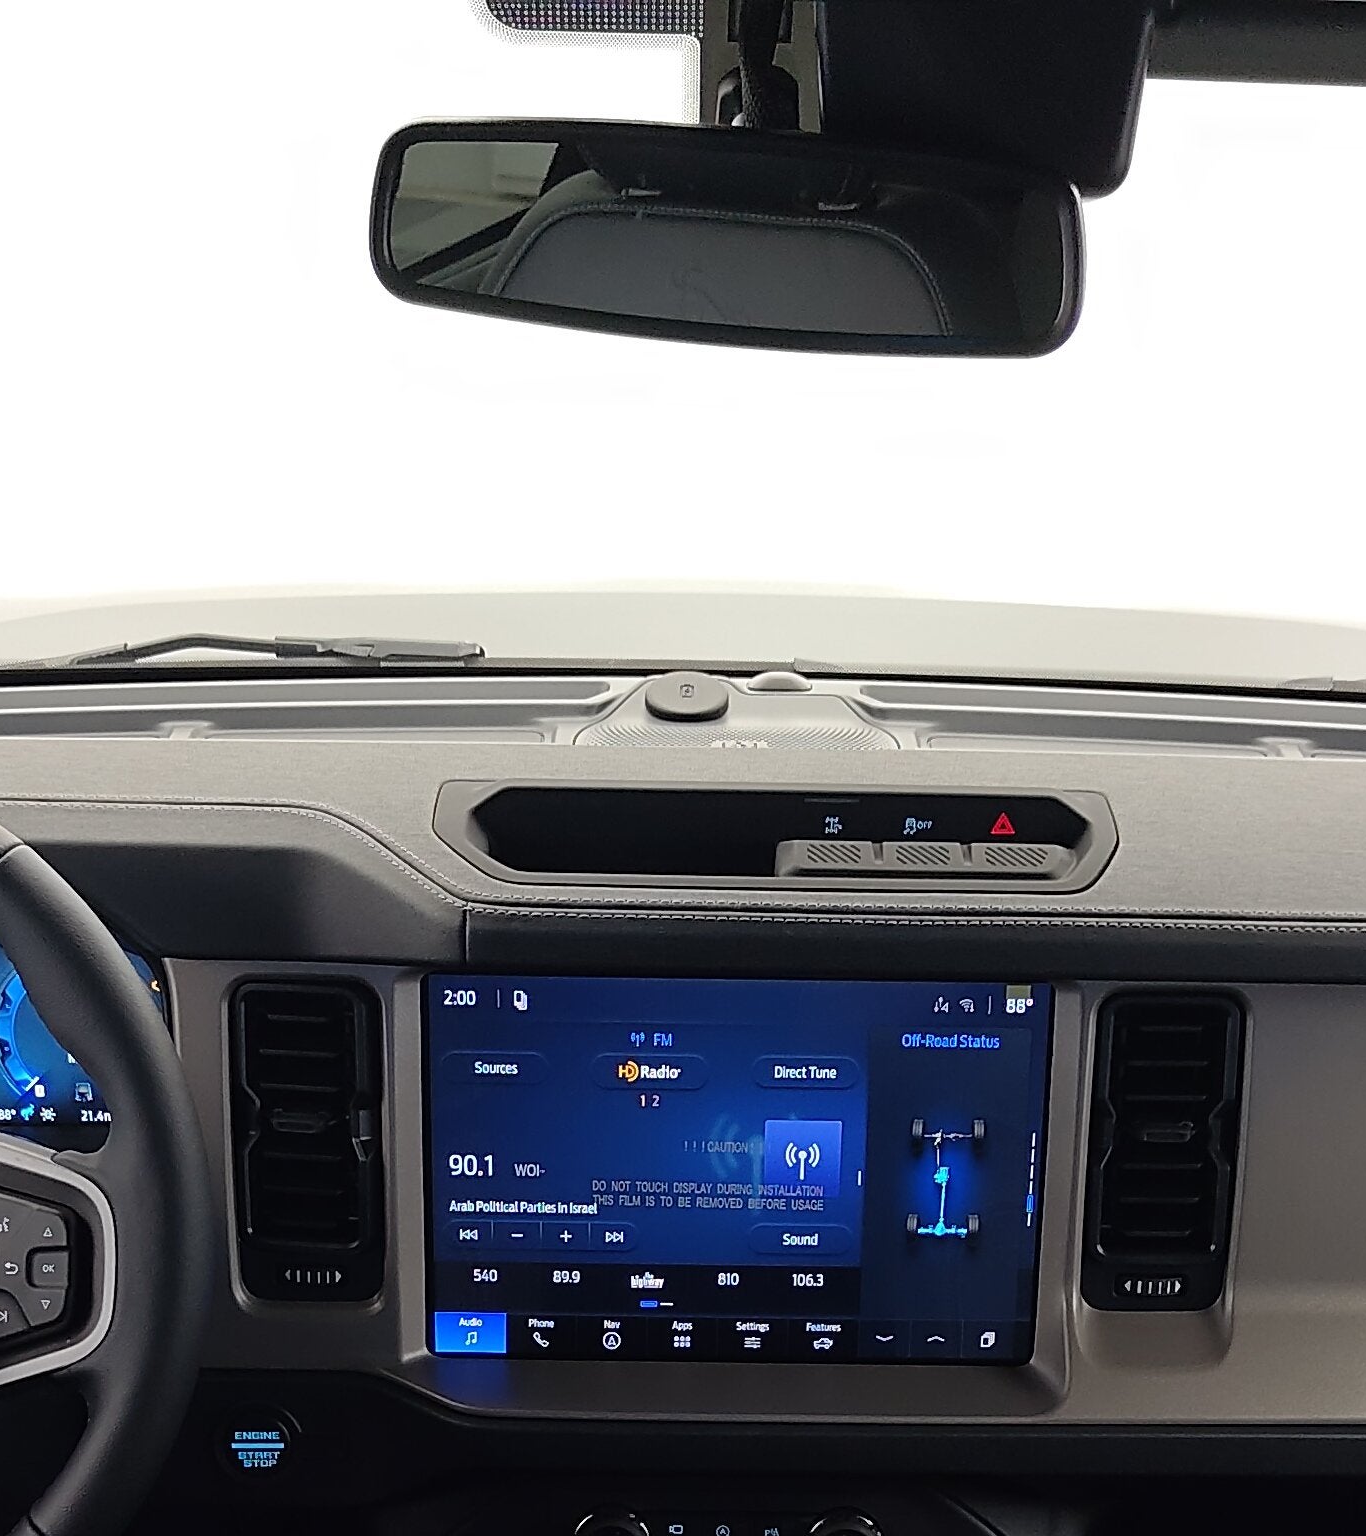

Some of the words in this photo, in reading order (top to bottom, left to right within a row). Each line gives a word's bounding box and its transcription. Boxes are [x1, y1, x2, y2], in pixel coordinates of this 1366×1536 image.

[443, 989, 477, 1007] 2:00
[653, 1032, 673, 1048] FM
[902, 1033, 958, 1049] Off-Road
[959, 1034, 1000, 1049] Status
[474, 1061, 519, 1076] Sources
[773, 1065, 807, 1080] Direct
[808, 1066, 837, 1080] Tune
[640, 1095, 647, 1107] 1
[651, 1095, 661, 1107] 2
[707, 1141, 748, 1154] CAUTION
[448, 1154, 495, 1178] 90.1
[592, 1180, 606, 1193] DO
[611, 1180, 631, 1193] NOT
[635, 1181, 669, 1194] TOUCH
[673, 1182, 712, 1195] DISPLAY
[717, 1183, 753, 1196] DURING
[758, 1184, 824, 1197] INSTALLATION
[449, 1200, 474, 1213] Arab
[475, 1200, 519, 1213] Political
[520, 1201, 556, 1214] Parties
[569, 1202, 598, 1214] Israel
[593, 1194, 614, 1207] THIS
[619, 1194, 640, 1207] FILM
[645, 1195, 655, 1207] IS
[660, 1195, 673, 1208] TO
[678, 1196, 692, 1208] BE
[696, 1197, 743, 1209] REMOVED
[747, 1198, 786, 1210] BEFORE
[791, 1199, 824, 1211] USAGE
[782, 1233, 819, 1246] Sound
[42, 1263, 55, 1273] OK
[473, 1269, 498, 1282] 540
[552, 1270, 581, 1283] 89.9
[717, 1273, 740, 1286] 810
[792, 1273, 824, 1287] 106.3
[459, 1316, 483, 1328] Audio
[528, 1317, 555, 1329] Phone
[603, 1319, 620, 1330] Nav
[671, 1321, 693, 1332] Apps
[735, 1322, 770, 1333] Settings
[805, 1323, 842, 1333] Features
[235, 1431, 280, 1440] ENGINE
[238, 1451, 281, 1460] START
[243, 1459, 277, 1467] STOP
